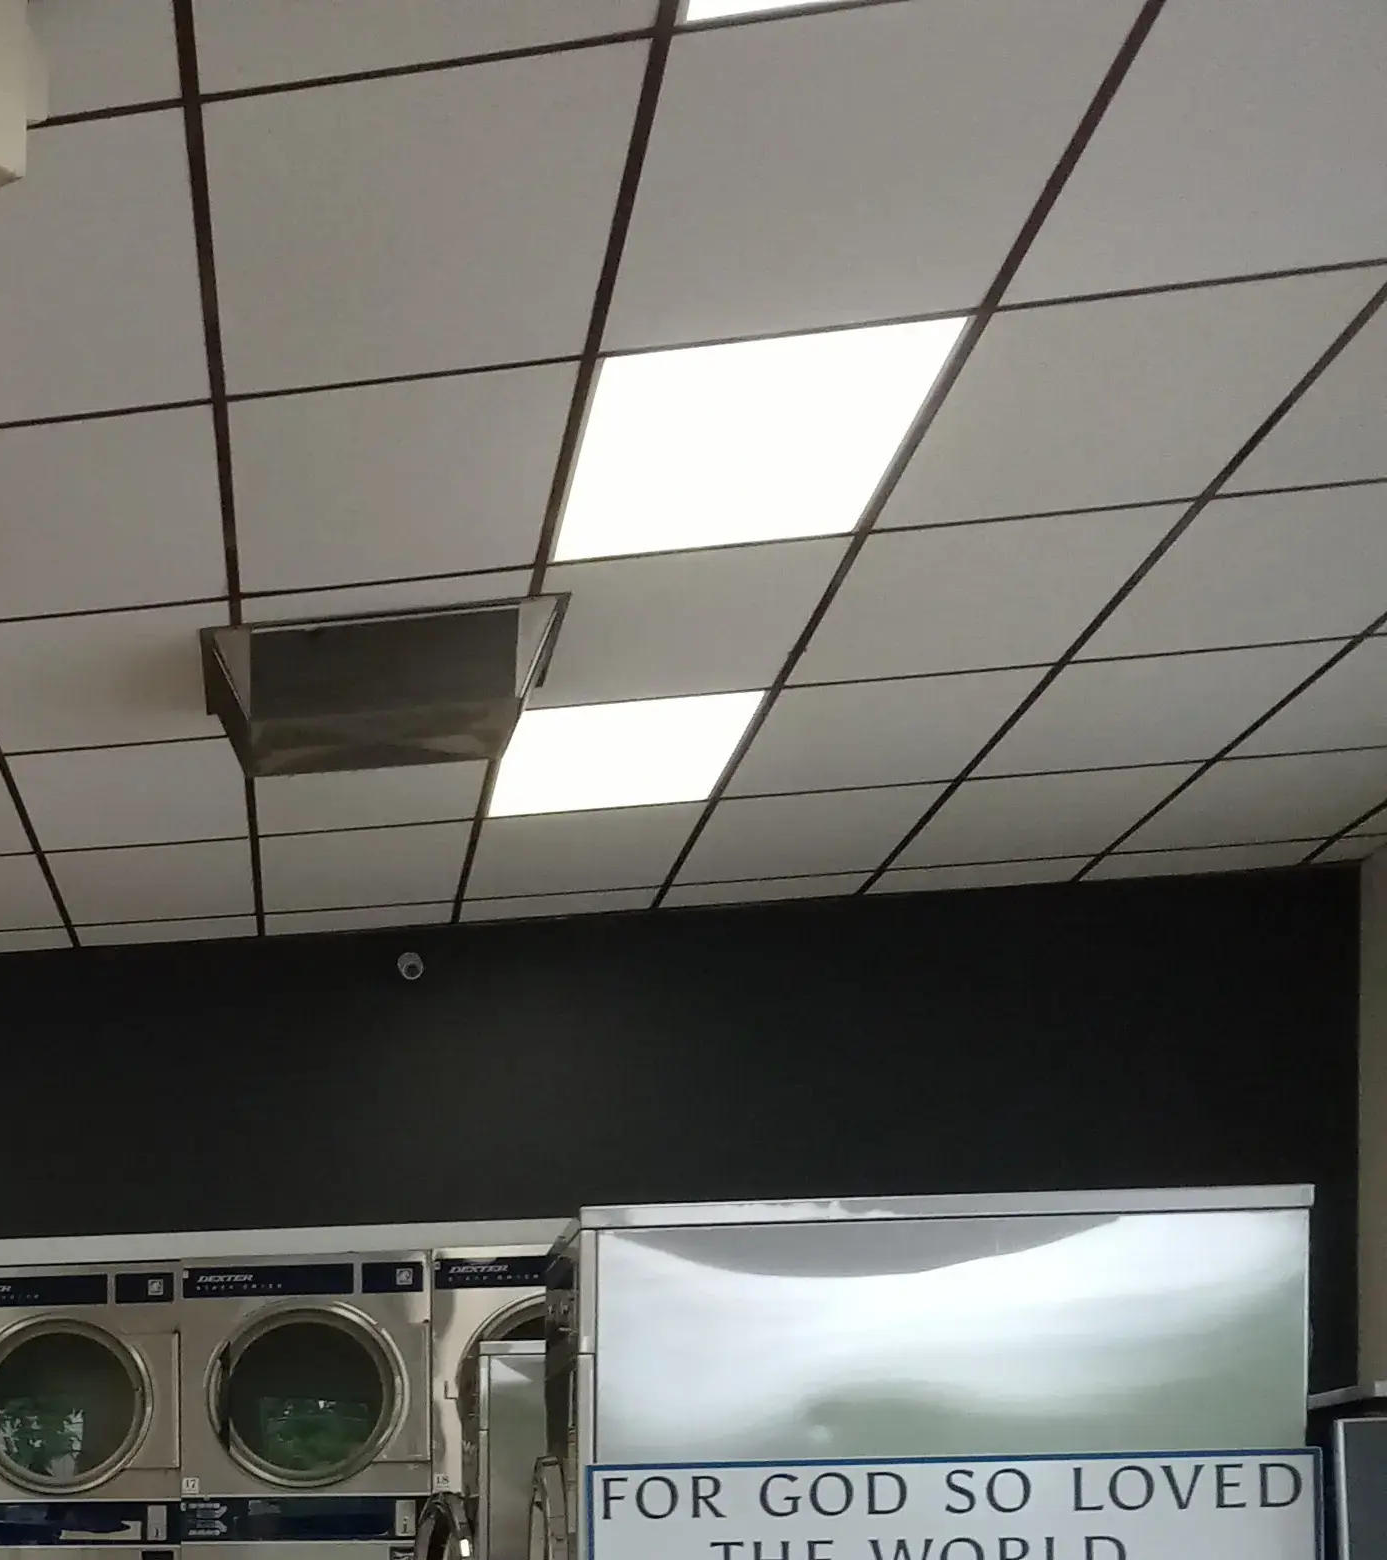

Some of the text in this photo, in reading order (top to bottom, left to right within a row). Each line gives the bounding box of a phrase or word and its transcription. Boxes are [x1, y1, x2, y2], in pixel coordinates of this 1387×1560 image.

[448, 1264, 509, 1274] DEXTER
[197, 1274, 253, 1283] DEXTER
[185, 1480, 196, 1490] 17
[602, 1463, 1302, 1519] FOR GOD SO LOVED
